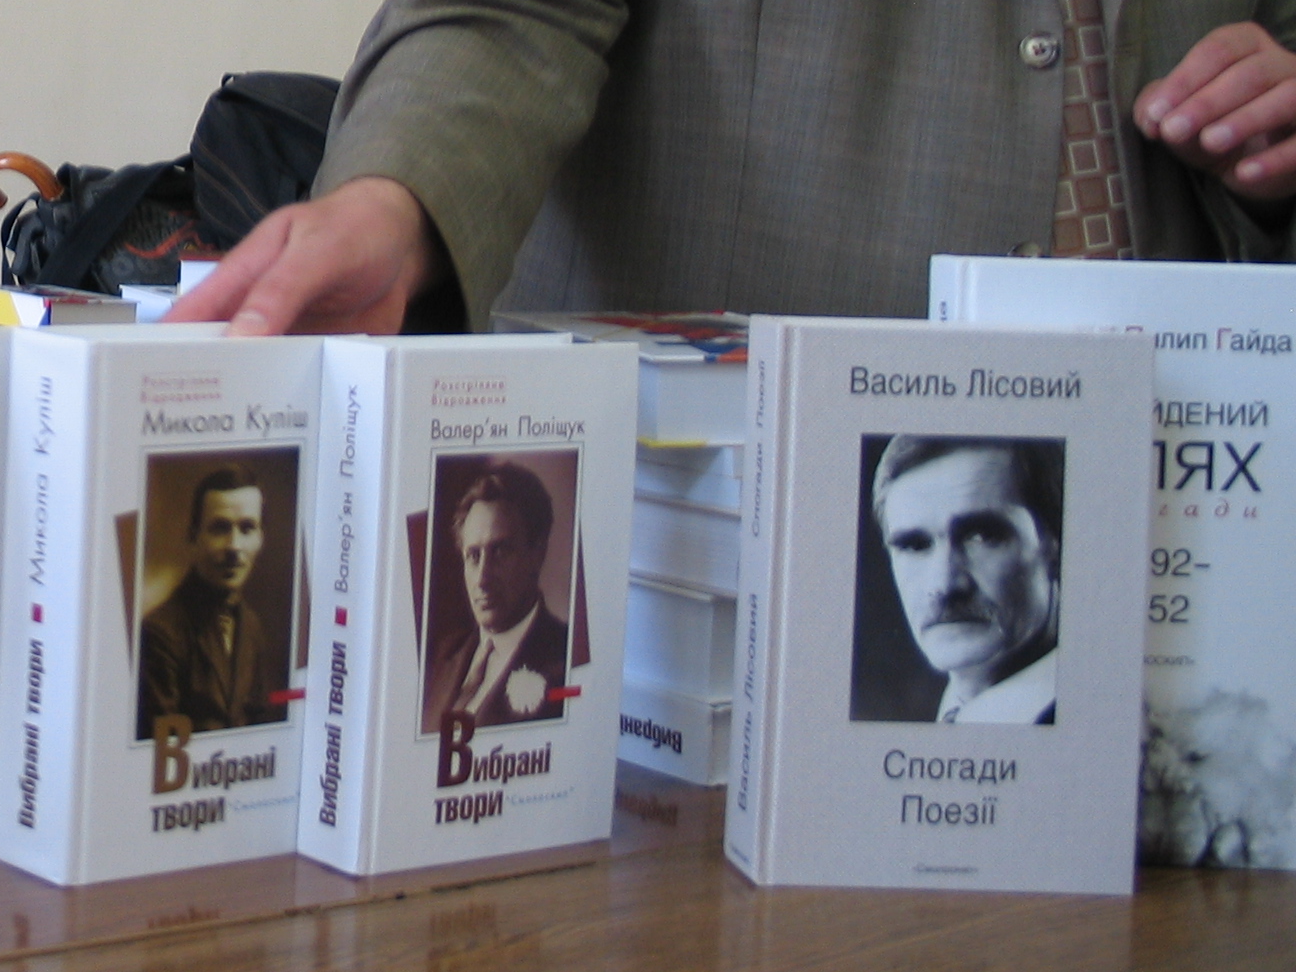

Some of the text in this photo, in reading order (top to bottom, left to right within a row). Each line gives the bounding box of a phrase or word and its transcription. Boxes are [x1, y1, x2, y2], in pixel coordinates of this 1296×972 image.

[1216, 328, 1292, 354] Гайда
[850, 366, 1081, 398] Василь Лісовий
[142, 408, 236, 436] Микола
[340, 384, 361, 478] Поліщук
[430, 415, 585, 445] Валер'ян Поліщук
[29, 473, 49, 586] Микола
[1148, 595, 1190, 624] 52
[27, 637, 46, 714] твори
[329, 640, 348, 716] твори
[152, 713, 276, 794] Вибрані
[437, 710, 552, 788] Вибрані
[620, 713, 682, 754] Вибрані
[17, 720, 40, 829] Вибрані
[319, 721, 342, 827] Вибрані
[738, 711, 752, 812] Василь
[883, 749, 1017, 785] Спогади
[152, 797, 225, 832] твори
[435, 791, 504, 824] твори
[901, 794, 998, 825] Поезії
